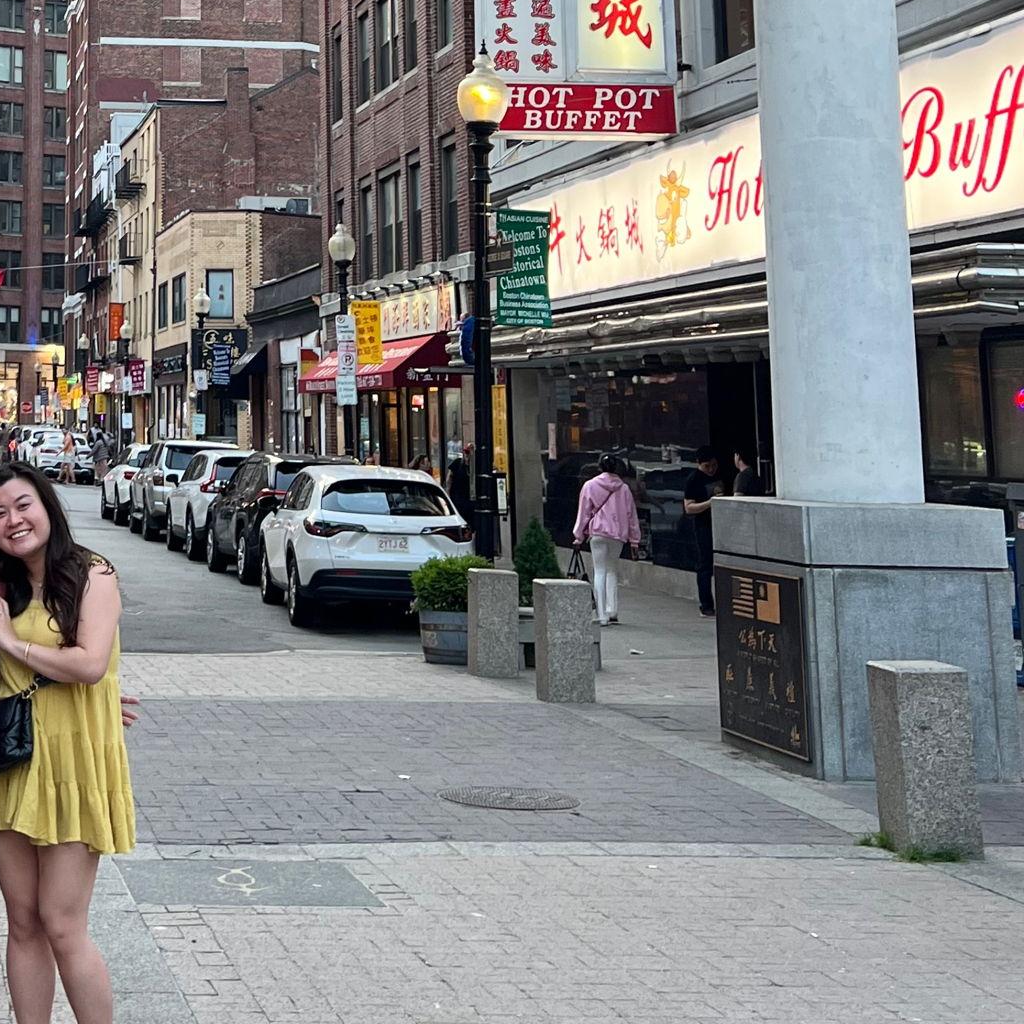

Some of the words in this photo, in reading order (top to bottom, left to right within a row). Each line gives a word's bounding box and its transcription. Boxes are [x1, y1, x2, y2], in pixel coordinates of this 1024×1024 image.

[506, 86, 573, 109] HOT
[594, 87, 660, 110] POT
[523, 110, 643, 131] BUFFET
[536, 225, 547, 239] To
[514, 243, 541, 257] ostons
[513, 256, 544, 273] storical
[499, 274, 546, 290] Chinatown
